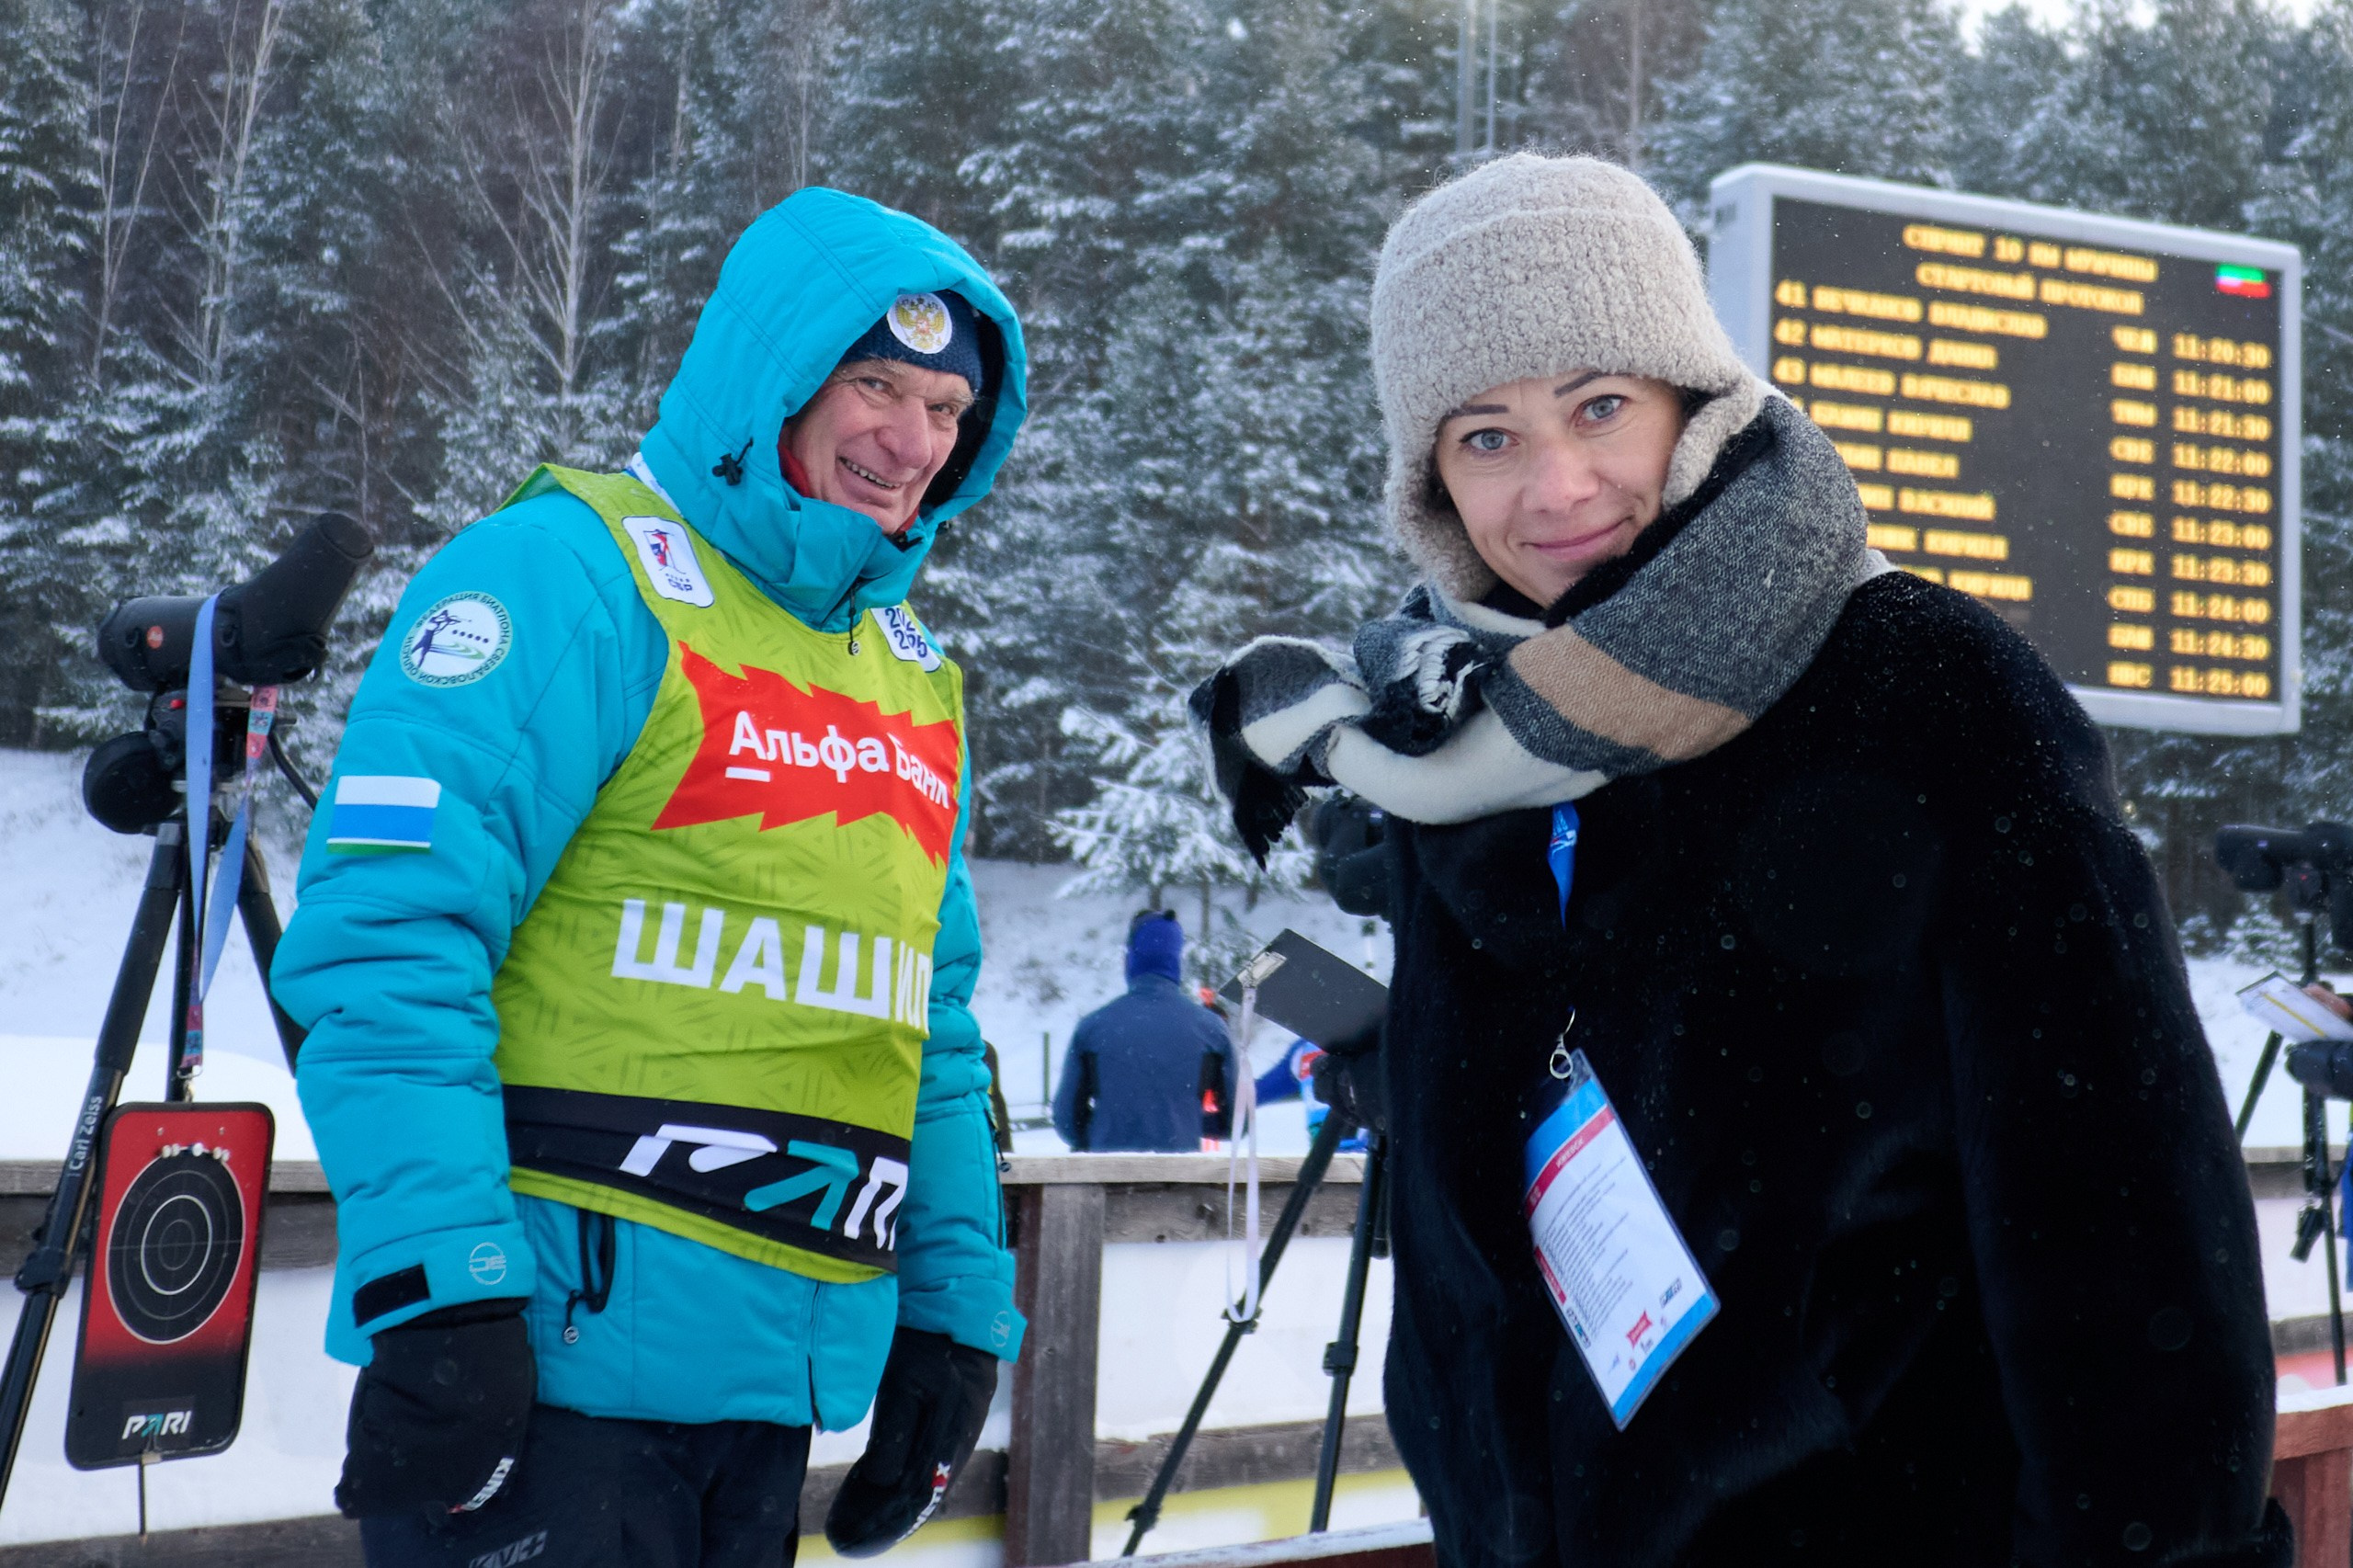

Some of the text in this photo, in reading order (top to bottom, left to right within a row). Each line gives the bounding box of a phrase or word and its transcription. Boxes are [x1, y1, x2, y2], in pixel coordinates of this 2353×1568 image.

[1995, 237, 2024, 263] 10
[1915, 261, 2144, 315] СТАРТОВЫЙ ПРОТОКОЛ
[1776, 280, 1806, 308] 41
[2174, 335, 2270, 369] 11:20:30
[1775, 319, 1805, 346] 42
[2174, 371, 2270, 404] 11:21:00
[2174, 408, 2270, 441] 11:21:30
[2173, 444, 2270, 477] 11:22:00
[2173, 481, 2270, 513] 11:22:30
[2173, 517, 2270, 551] 11:23:00
[2173, 555, 2270, 587] 11:23:30
[2172, 593, 2270, 624] 11:24:00
[2172, 631, 2269, 661] 11:24:30
[2171, 667, 2269, 697] 11:25:00
[728, 710, 891, 784] Альфа
[611, 898, 930, 1035] ШАШИЛ
[69, 1096, 104, 1171] Carl Zeiss
[618, 1123, 909, 1253] PAR
[120, 1409, 192, 1441] PARI
